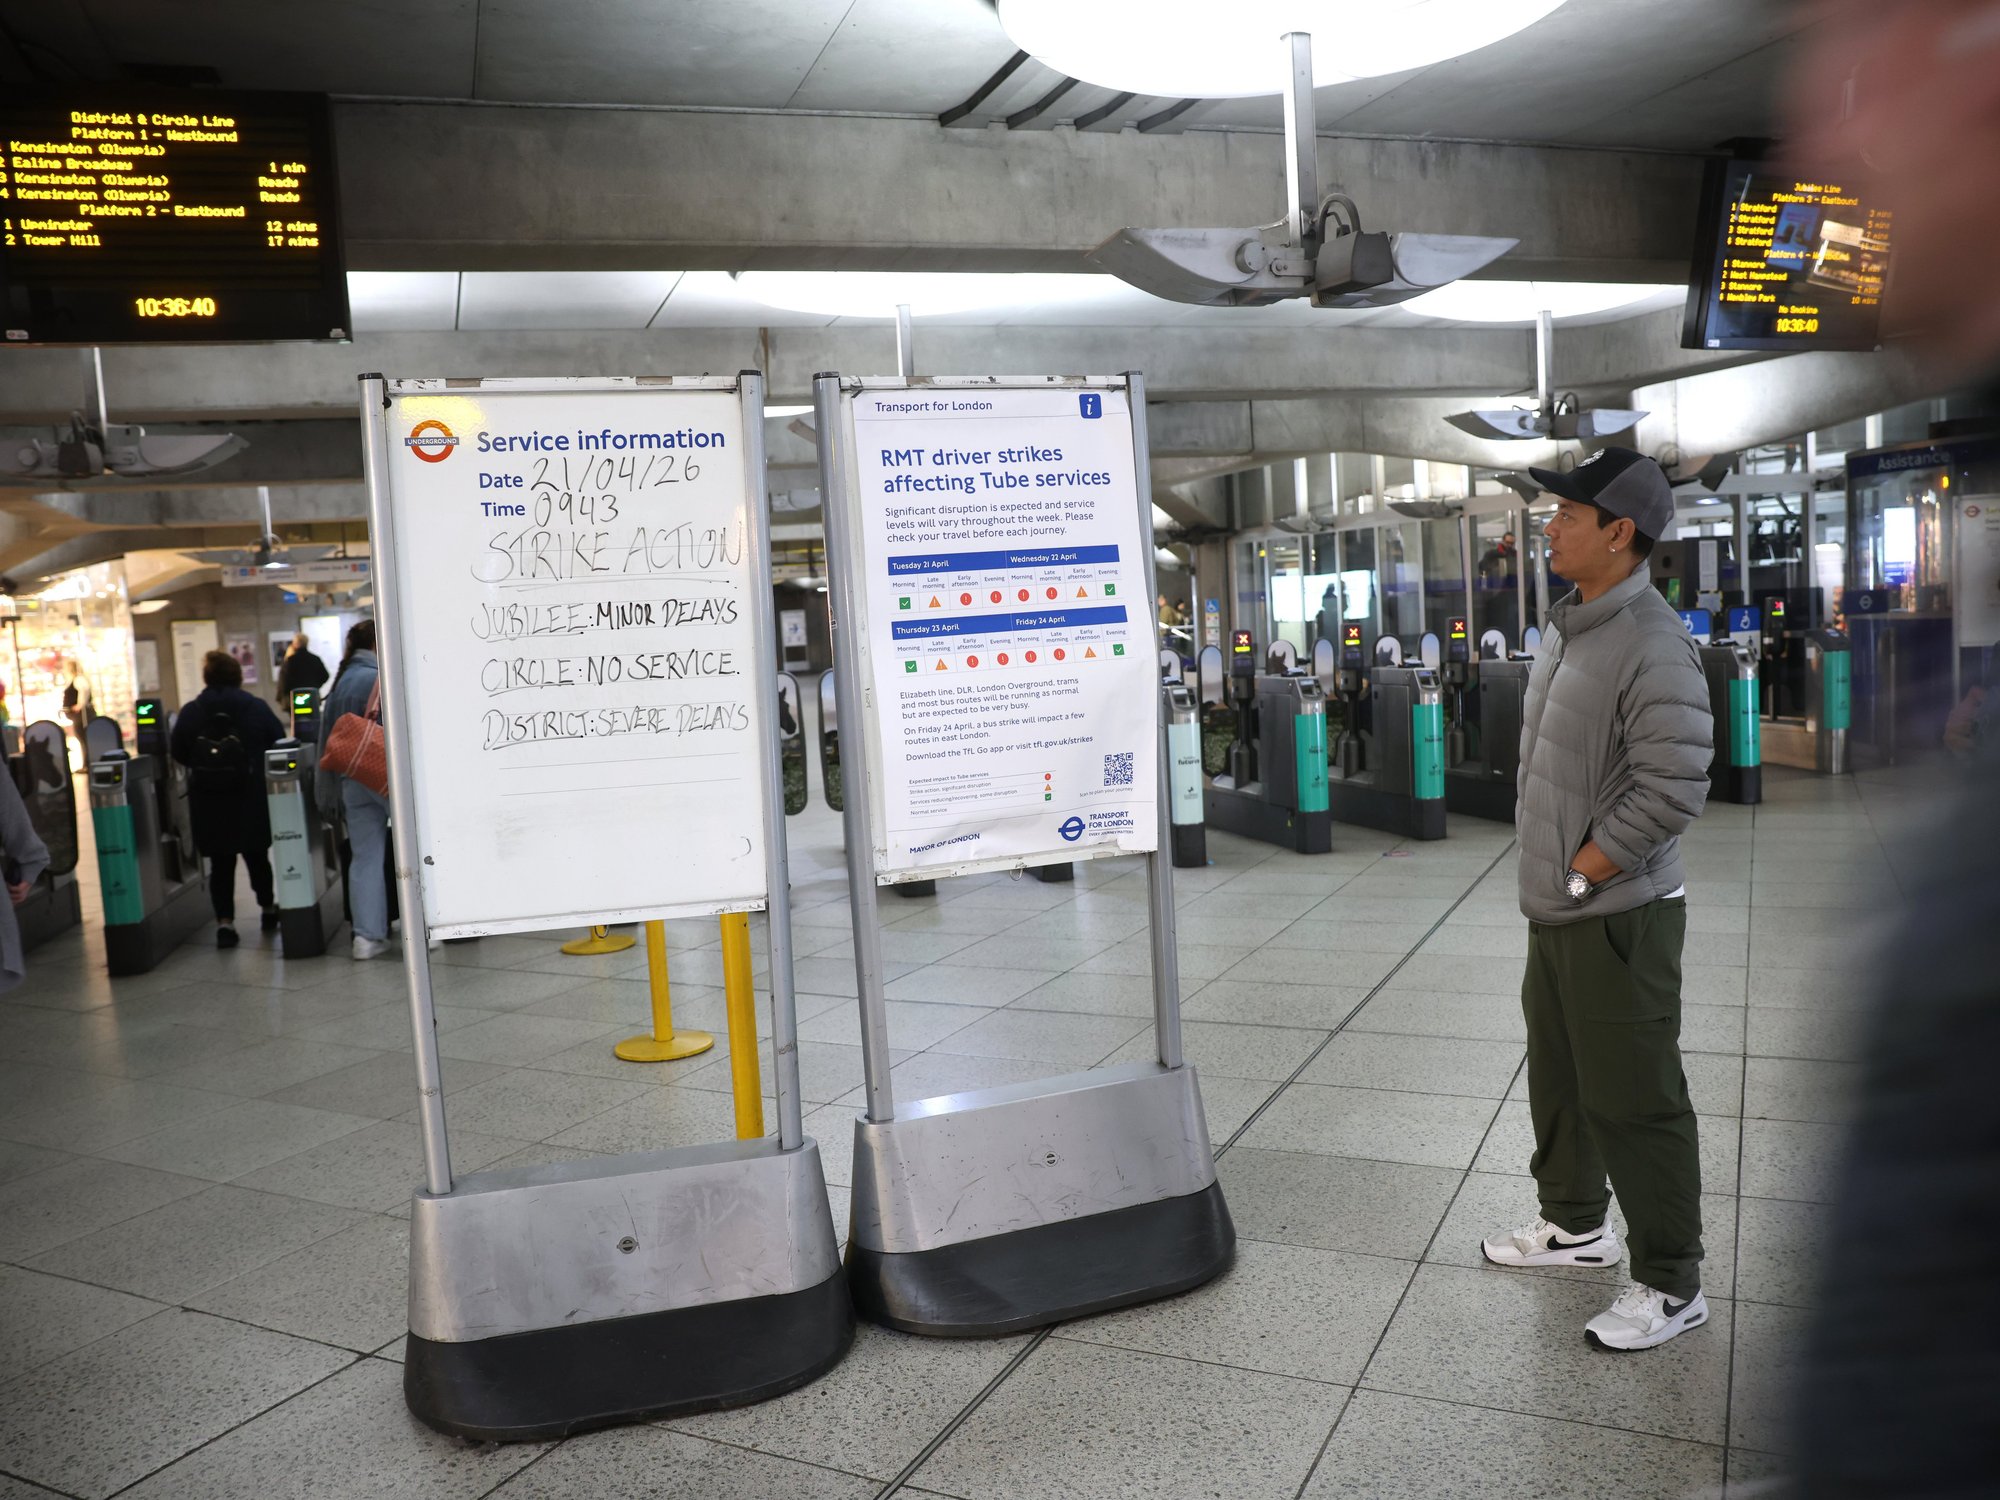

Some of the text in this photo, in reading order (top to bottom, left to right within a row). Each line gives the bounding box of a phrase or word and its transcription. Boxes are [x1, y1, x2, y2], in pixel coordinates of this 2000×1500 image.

[71, 111, 235, 127] District & Circle Line
[71, 127, 238, 142] Platform 1 Westbound
[10, 140, 166, 156] Kensington (Olympia)
[12, 156, 62, 169] Ealing
[65, 158, 133, 171] Broadway
[269, 162, 306, 173] 1 min
[14, 172, 96, 185] Kensington
[101, 174, 169, 186] (Olympia)
[258, 176, 299, 188] Ready
[0, 187, 171, 201] 4 Kensington (Olympia)
[260, 191, 300, 203] Ready
[79, 204, 245, 217] Platform 2 Eastbound
[4, 218, 93, 231] 1 Upminster
[266, 220, 318, 232] 12 mins
[5, 234, 101, 246] 2 Tower Hill
[268, 235, 319, 247] 17 mins
[136, 297, 216, 317] 10:36:40
[874, 400, 993, 414] Transport for London
[477, 428, 726, 452] Service information
[881, 445, 1063, 467] RMT driver strikes
[1878, 452, 1951, 470] Assistance
[479, 472, 524, 488] Date
[530, 455, 700, 492] 21/04/26
[884, 469, 1111, 494] affecting Tube services
[481, 502, 526, 517] Time
[535, 492, 618, 527] 0943
[885, 499, 1095, 519] Significant disruption is expected and service
[886, 512, 1094, 530] levels will vary throughout the week. Please
[886, 526, 1067, 543] check your travel before each journey.
[471, 521, 743, 582] STRIKE ACTION
[1010, 554, 1050, 563] Wednesday
[1060, 553, 1078, 562] April
[892, 560, 950, 570] Tuesday 21 April
[596, 602, 655, 630] MINOR
[662, 598, 738, 626] DELAYS
[1015, 618, 1037, 626] Friday
[1048, 615, 1066, 624] April
[896, 625, 930, 634] Thursday
[941, 623, 960, 632] April
[588, 656, 622, 686] NO
[899, 689, 937, 700] Elizabeth
[976, 684, 1006, 693] London
[597, 709, 670, 736] SEVERE
[676, 704, 749, 736] DELAYS
[903, 727, 917, 736] On
[917, 725, 942, 734] Friday
[943, 724, 952, 732] 24
[998, 718, 1020, 727] strike
[1021, 716, 1036, 724] will
[1037, 714, 1064, 724] impact
[1070, 712, 1085, 720] few
[906, 750, 946, 762] Download
[947, 750, 961, 758] the
[962, 747, 975, 756] TfL
[976, 746, 989, 754] Go
[989, 746, 1004, 754] app
[1033, 736, 1094, 749] tfl.gov.uk/strikes
[1089, 810, 1129, 821] TRANSPORT
[1103, 819, 1134, 828] LONDON
[909, 843, 936, 854] MAYOR
[947, 832, 980, 845] LONDON
